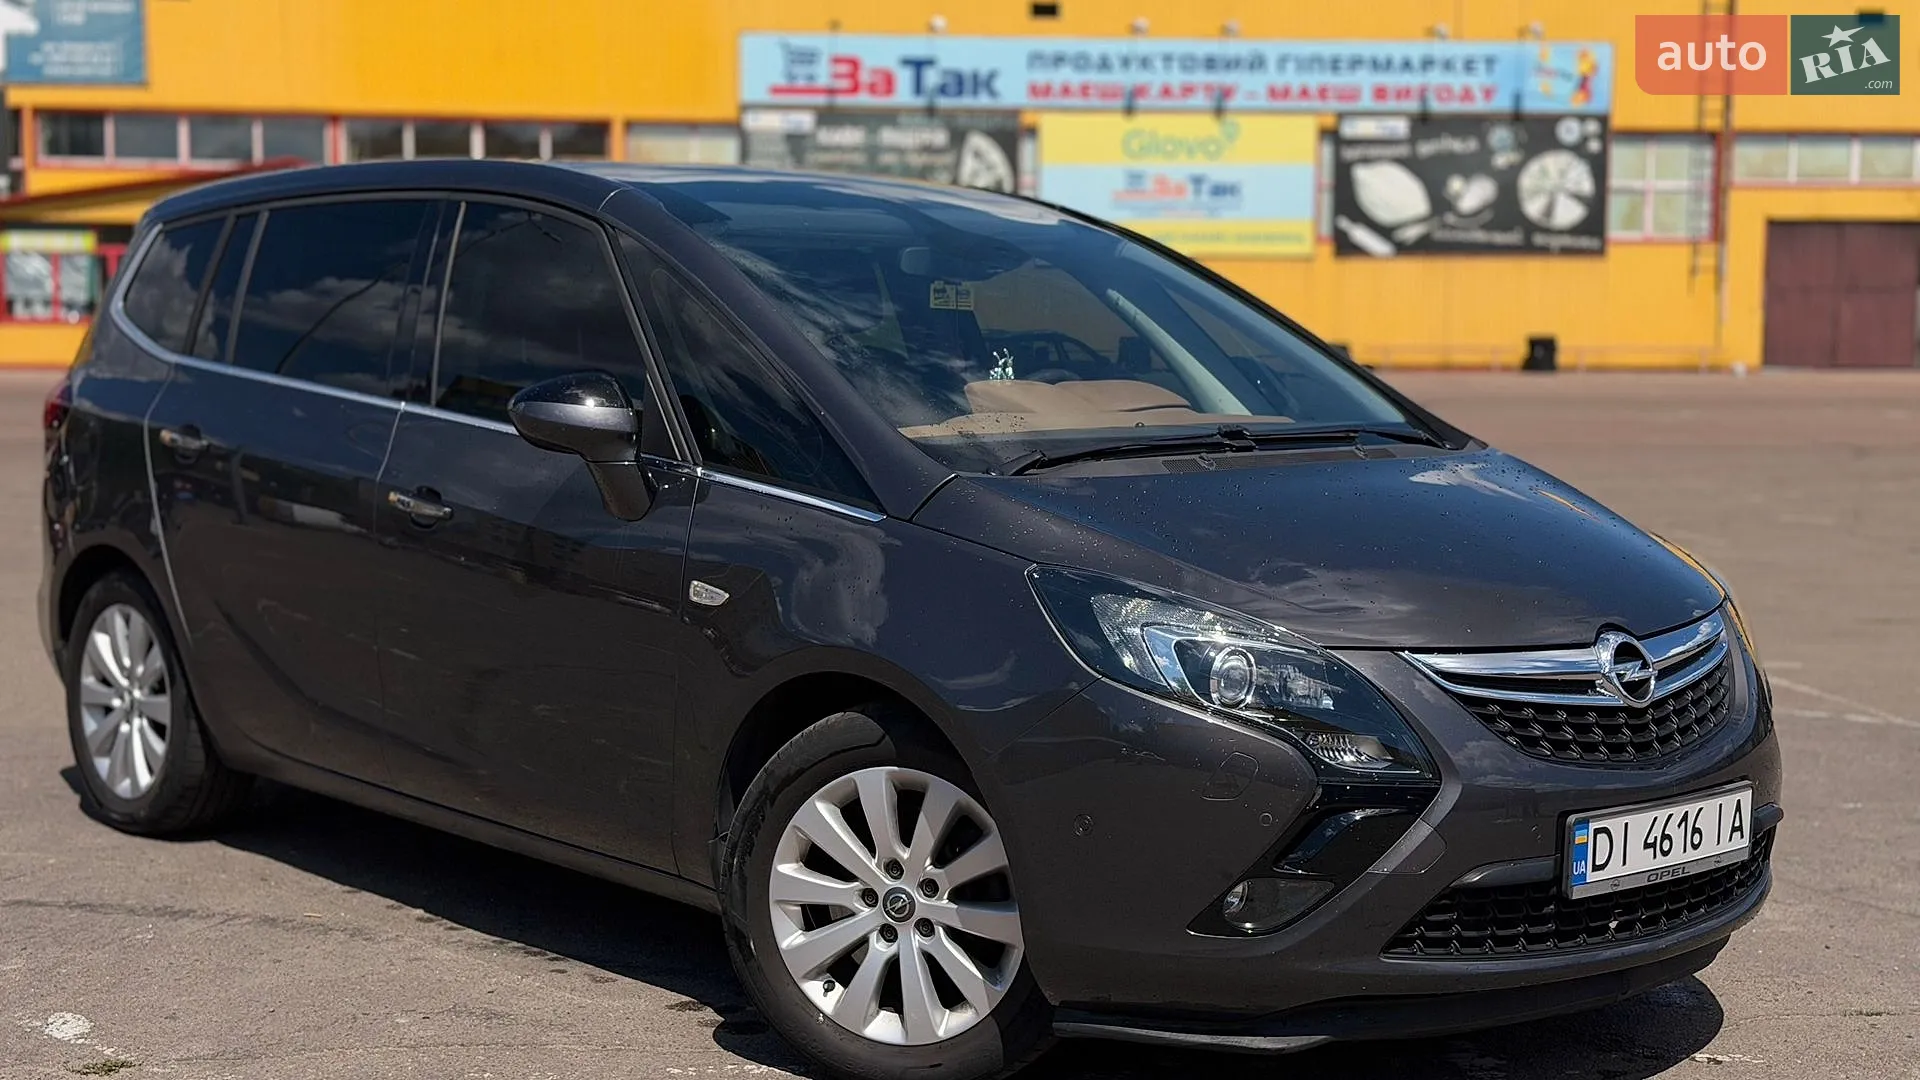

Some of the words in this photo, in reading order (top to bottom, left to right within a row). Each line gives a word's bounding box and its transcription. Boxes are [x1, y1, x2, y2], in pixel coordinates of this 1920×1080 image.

[1027, 50, 1267, 74] ПРОДУКТОВИЙ
[1276, 53, 1497, 77] ГІПЕРМАРКЕТ
[1131, 82, 1236, 101] КАРТУ
[1372, 83, 1498, 104] ВИГОДУ
[1122, 129, 1226, 160] Glovo
[1591, 821, 1629, 873] DI
[1642, 806, 1704, 860] 4616
[1716, 798, 1744, 847] IA
[1573, 861, 1586, 875] UA
[1646, 866, 1690, 883] OPEL
